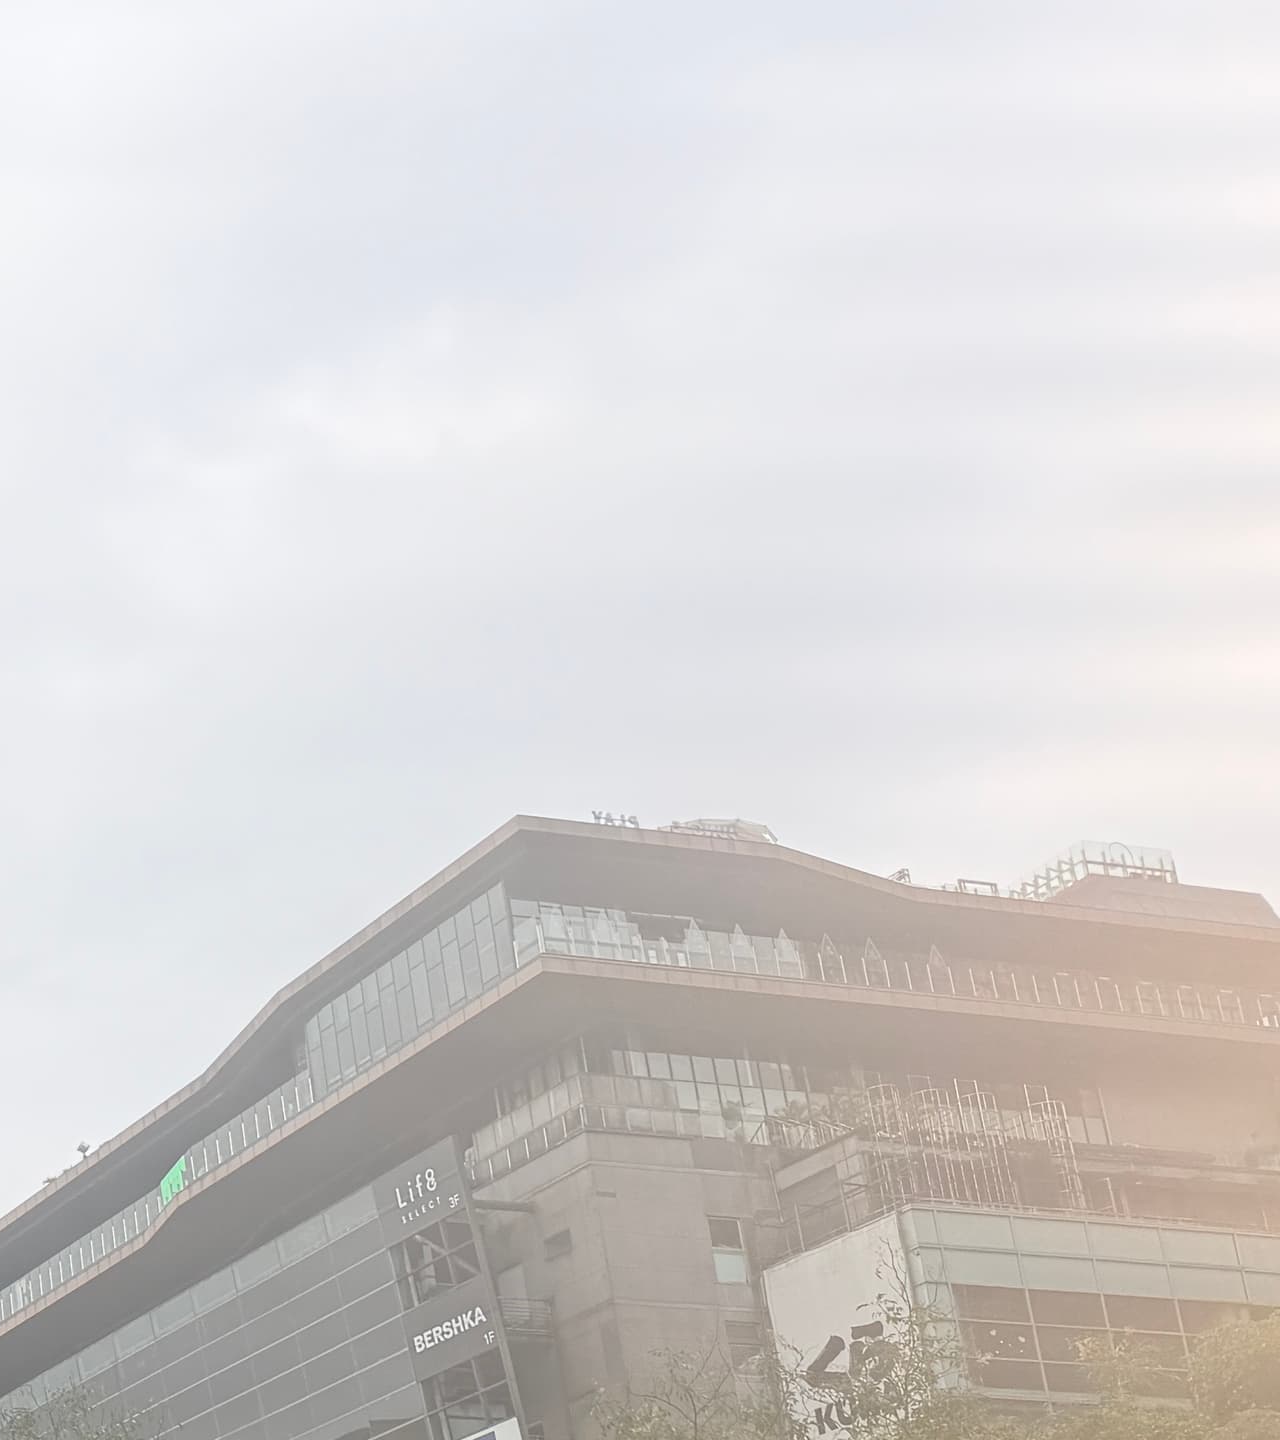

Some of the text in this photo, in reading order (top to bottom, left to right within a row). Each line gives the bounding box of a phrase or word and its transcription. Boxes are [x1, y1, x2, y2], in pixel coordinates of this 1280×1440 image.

[448, 1193, 460, 1208] 3F
[413, 1306, 487, 1353] BERSHKA
[483, 1330, 496, 1345] 1F
